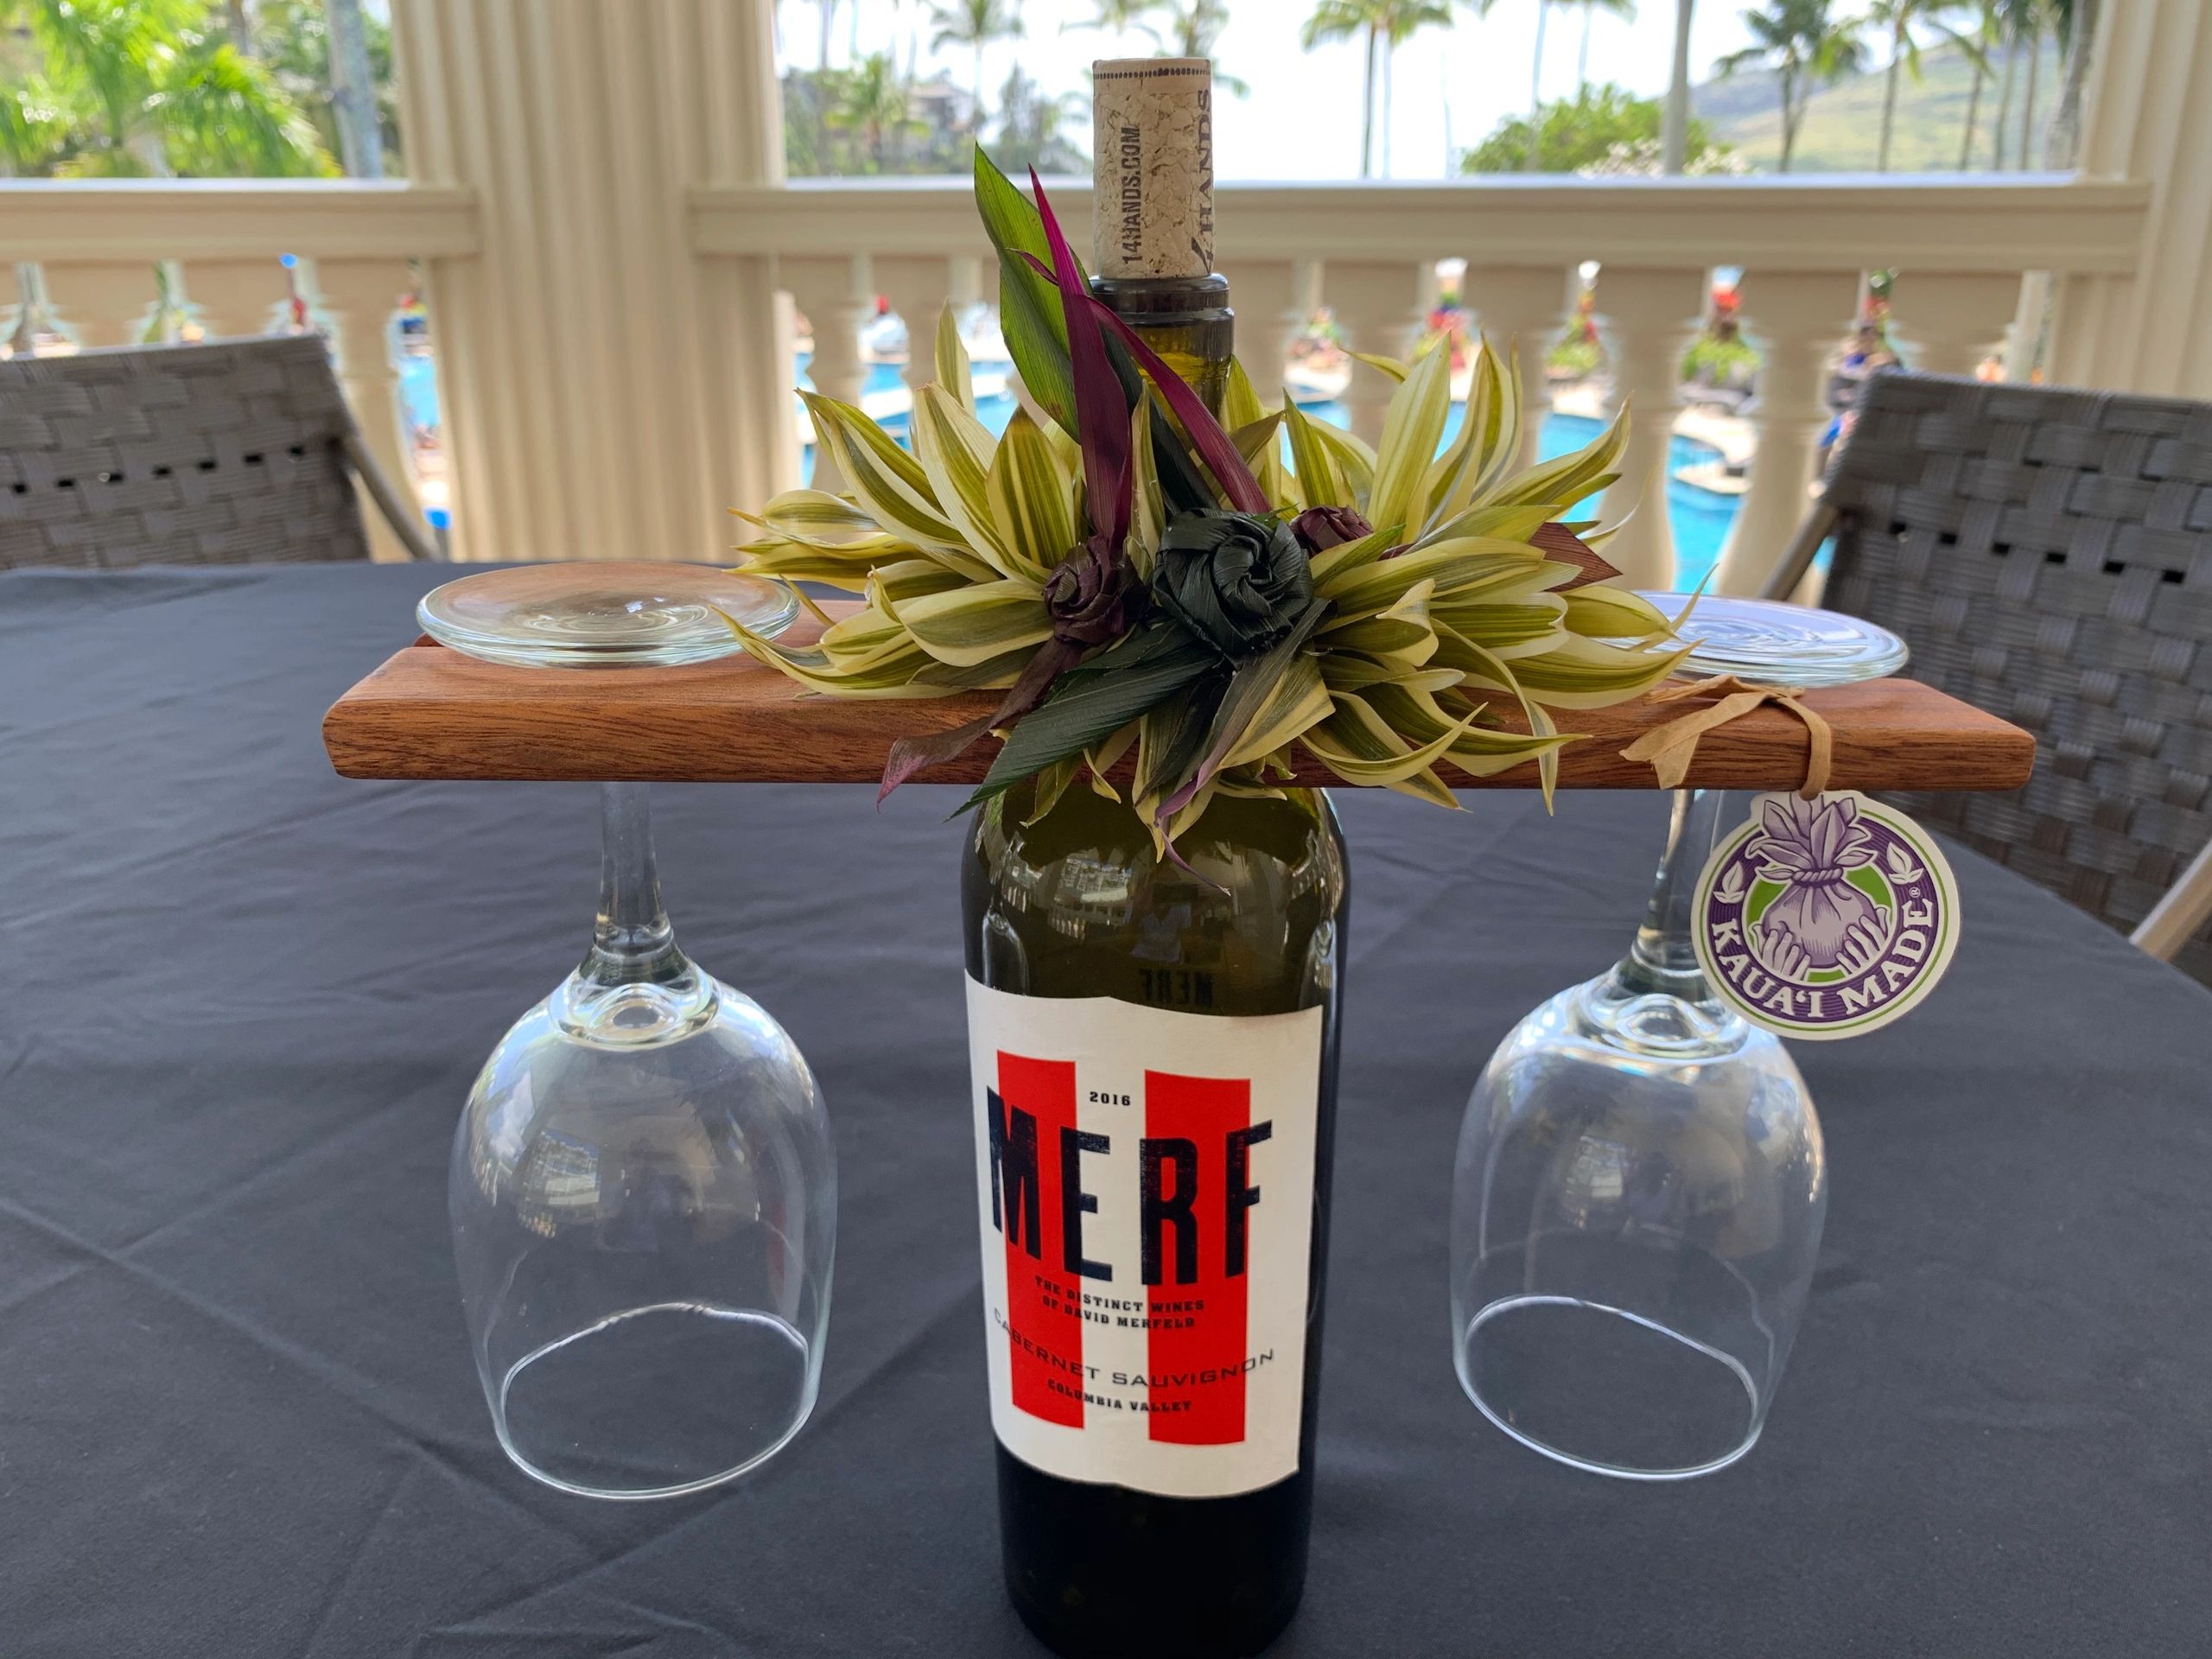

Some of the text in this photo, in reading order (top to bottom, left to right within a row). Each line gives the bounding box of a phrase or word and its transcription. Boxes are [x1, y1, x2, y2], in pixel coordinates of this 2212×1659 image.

[1121, 127, 1142, 264] 14HANDS.COM
[1090, 1090, 1131, 1107] 2016
[987, 1085, 1273, 1286] MERF
[1034, 1274, 1205, 1313] THE DISTINCT WINES
[1042, 1295, 1195, 1329] OF DAVID MERFELD
[994, 1307, 1274, 1388] CABERNET SAUVIGNON
[1047, 1379, 1192, 1413] COLUMBIA VALLEY
